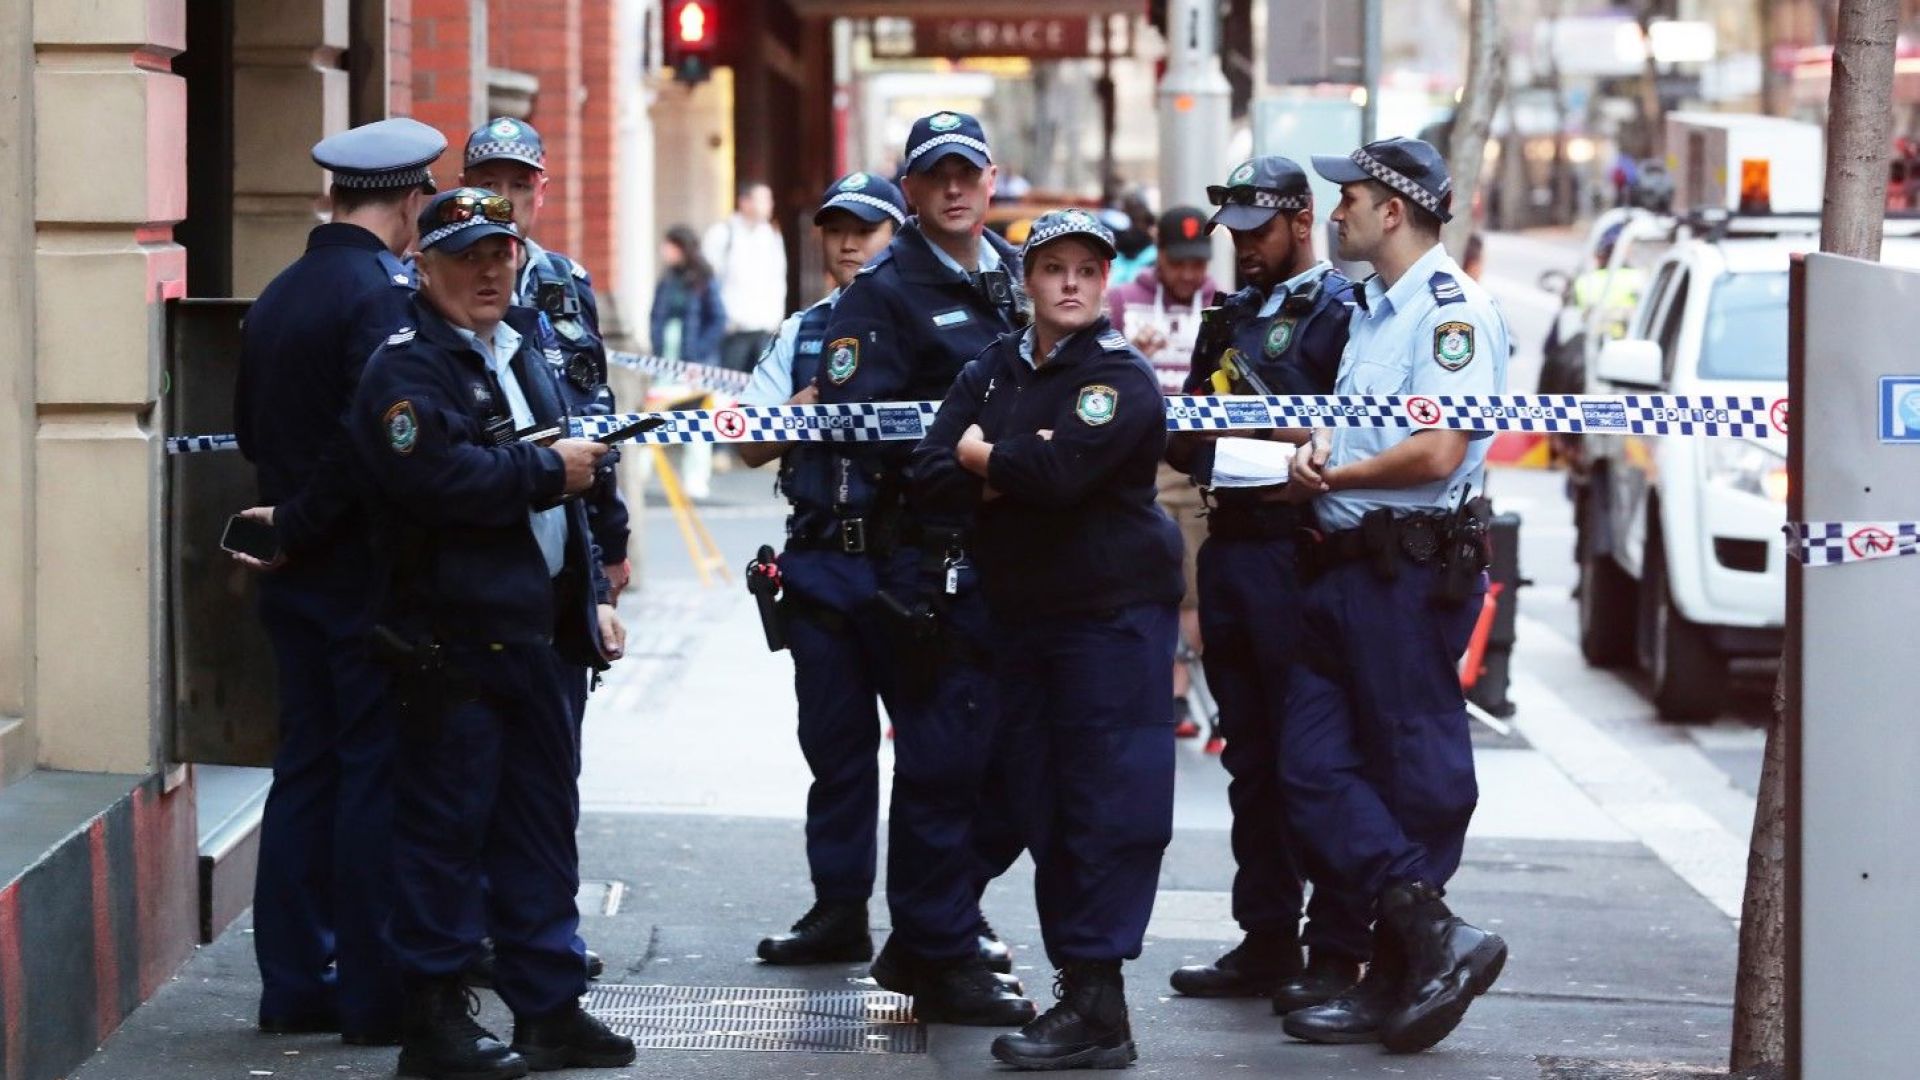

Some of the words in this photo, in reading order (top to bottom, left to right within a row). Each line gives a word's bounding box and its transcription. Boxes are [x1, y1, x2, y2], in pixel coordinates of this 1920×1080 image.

[1297, 405, 1369, 417] POLICE
[1656, 407, 1729, 422] POLICE
[783, 415, 853, 429] POLICE
